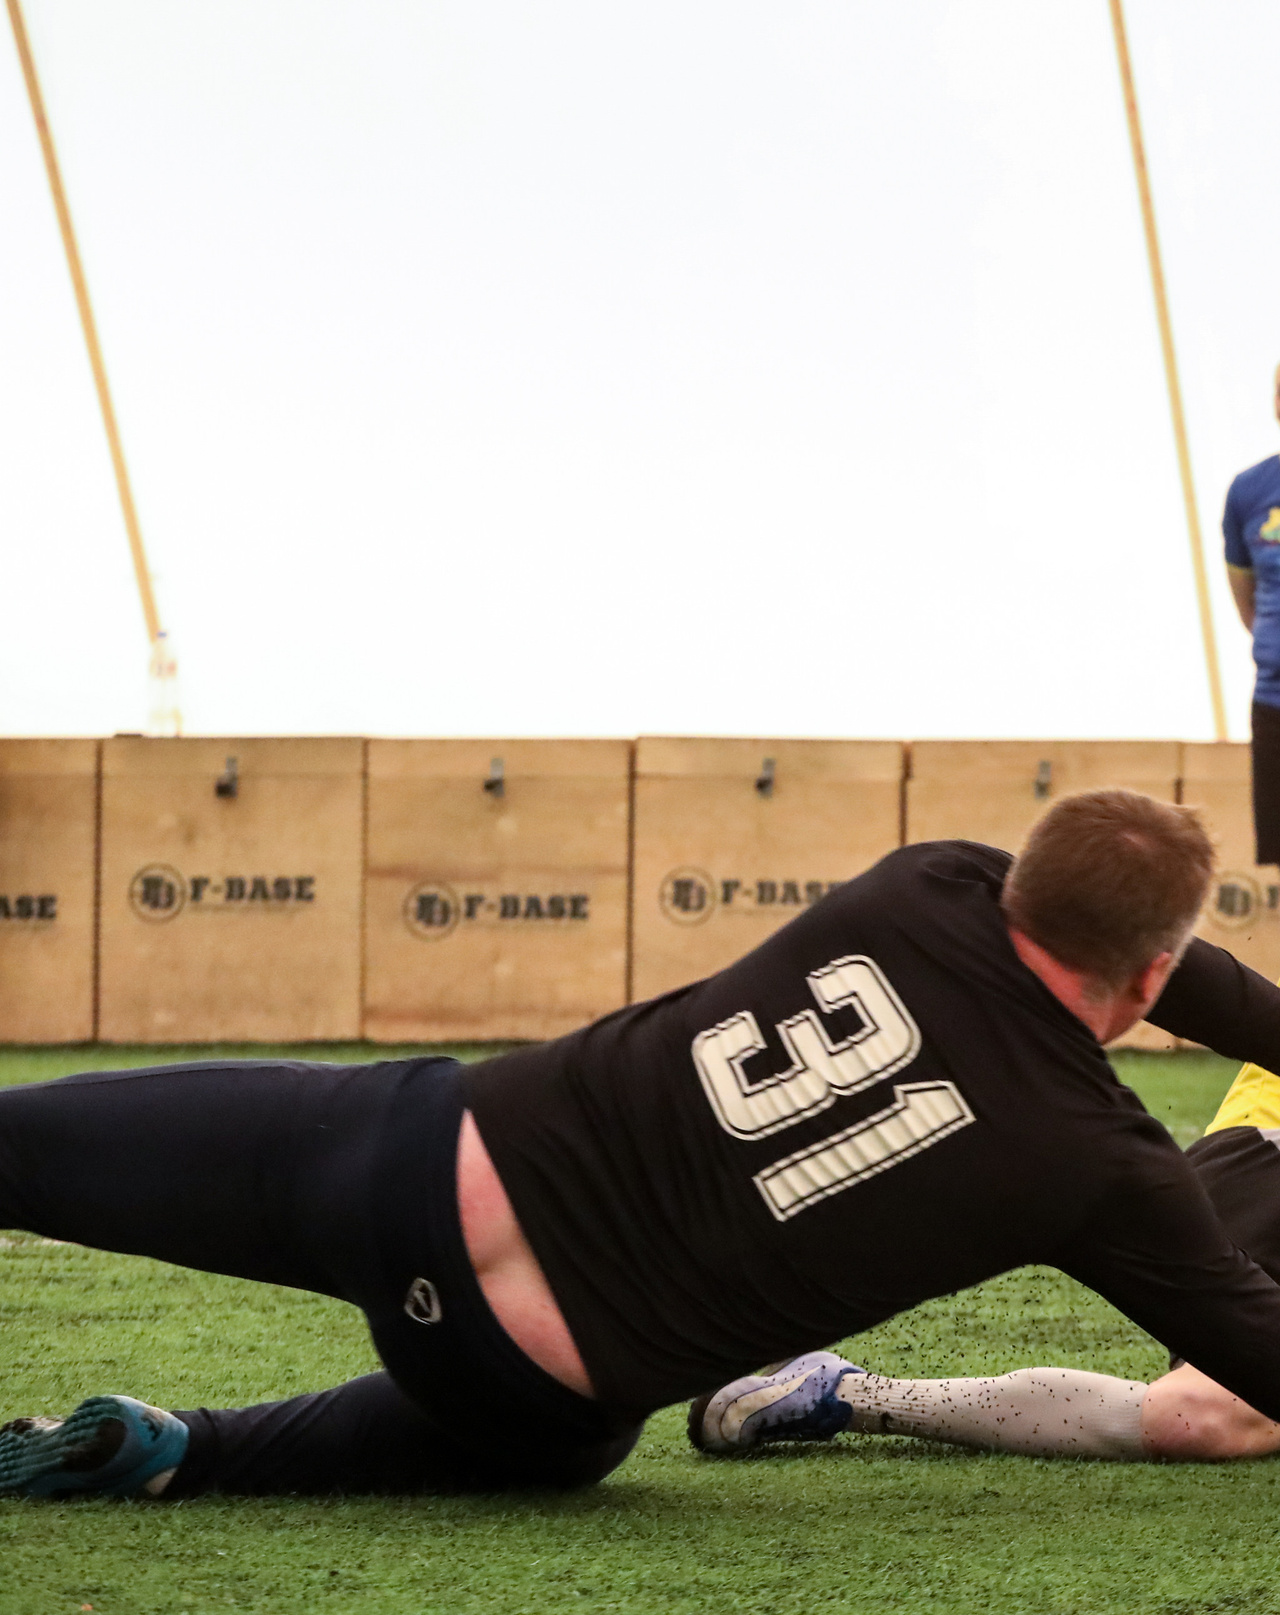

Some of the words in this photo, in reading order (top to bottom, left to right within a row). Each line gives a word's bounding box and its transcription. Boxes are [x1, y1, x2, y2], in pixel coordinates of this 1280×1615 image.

[190, 876, 315, 902] F-BASE
[464, 894, 590, 920] F-BASE
[691, 954, 977, 1222] 31
